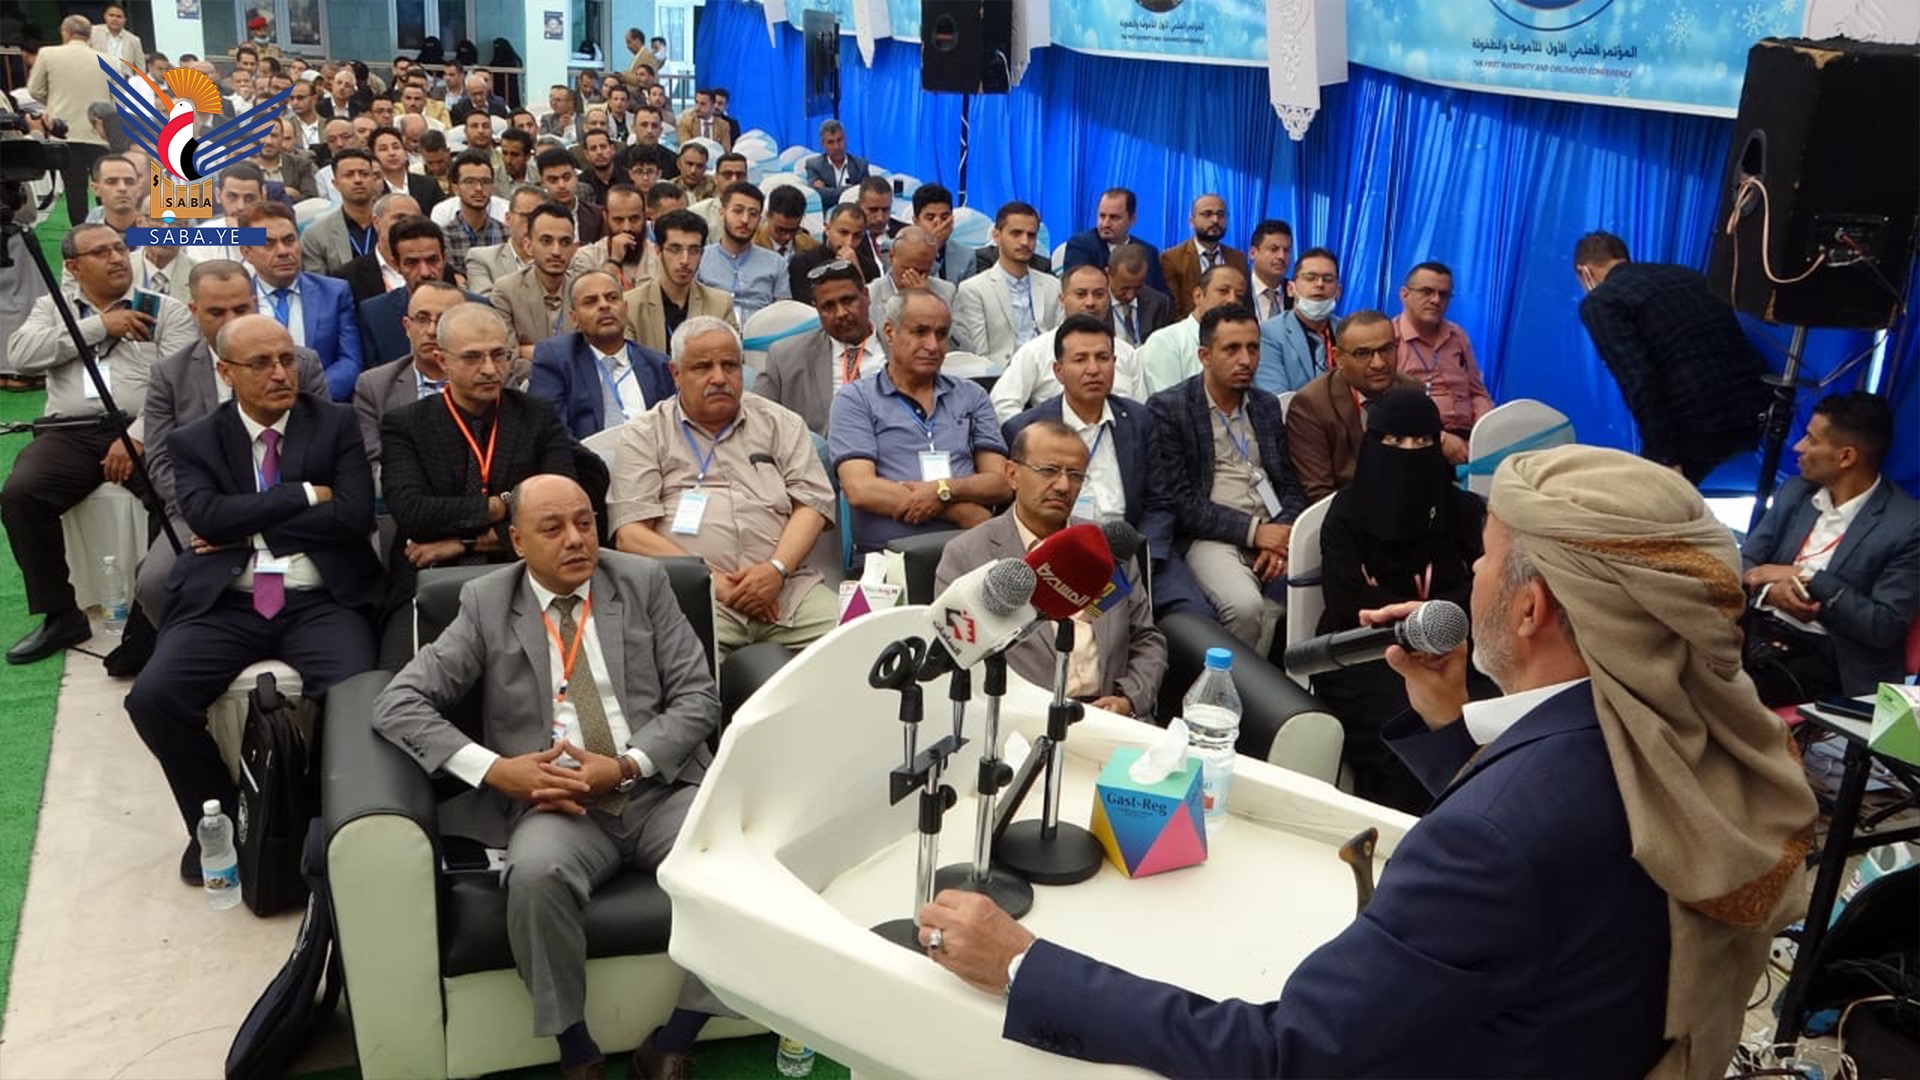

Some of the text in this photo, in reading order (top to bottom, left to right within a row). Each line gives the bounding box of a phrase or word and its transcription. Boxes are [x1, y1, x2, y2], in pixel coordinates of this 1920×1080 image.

[1569, 43, 1601, 61] العلمي
[1602, 44, 1637, 61] المؤتمر
[1106, 791, 1168, 817] Gast-Reg
